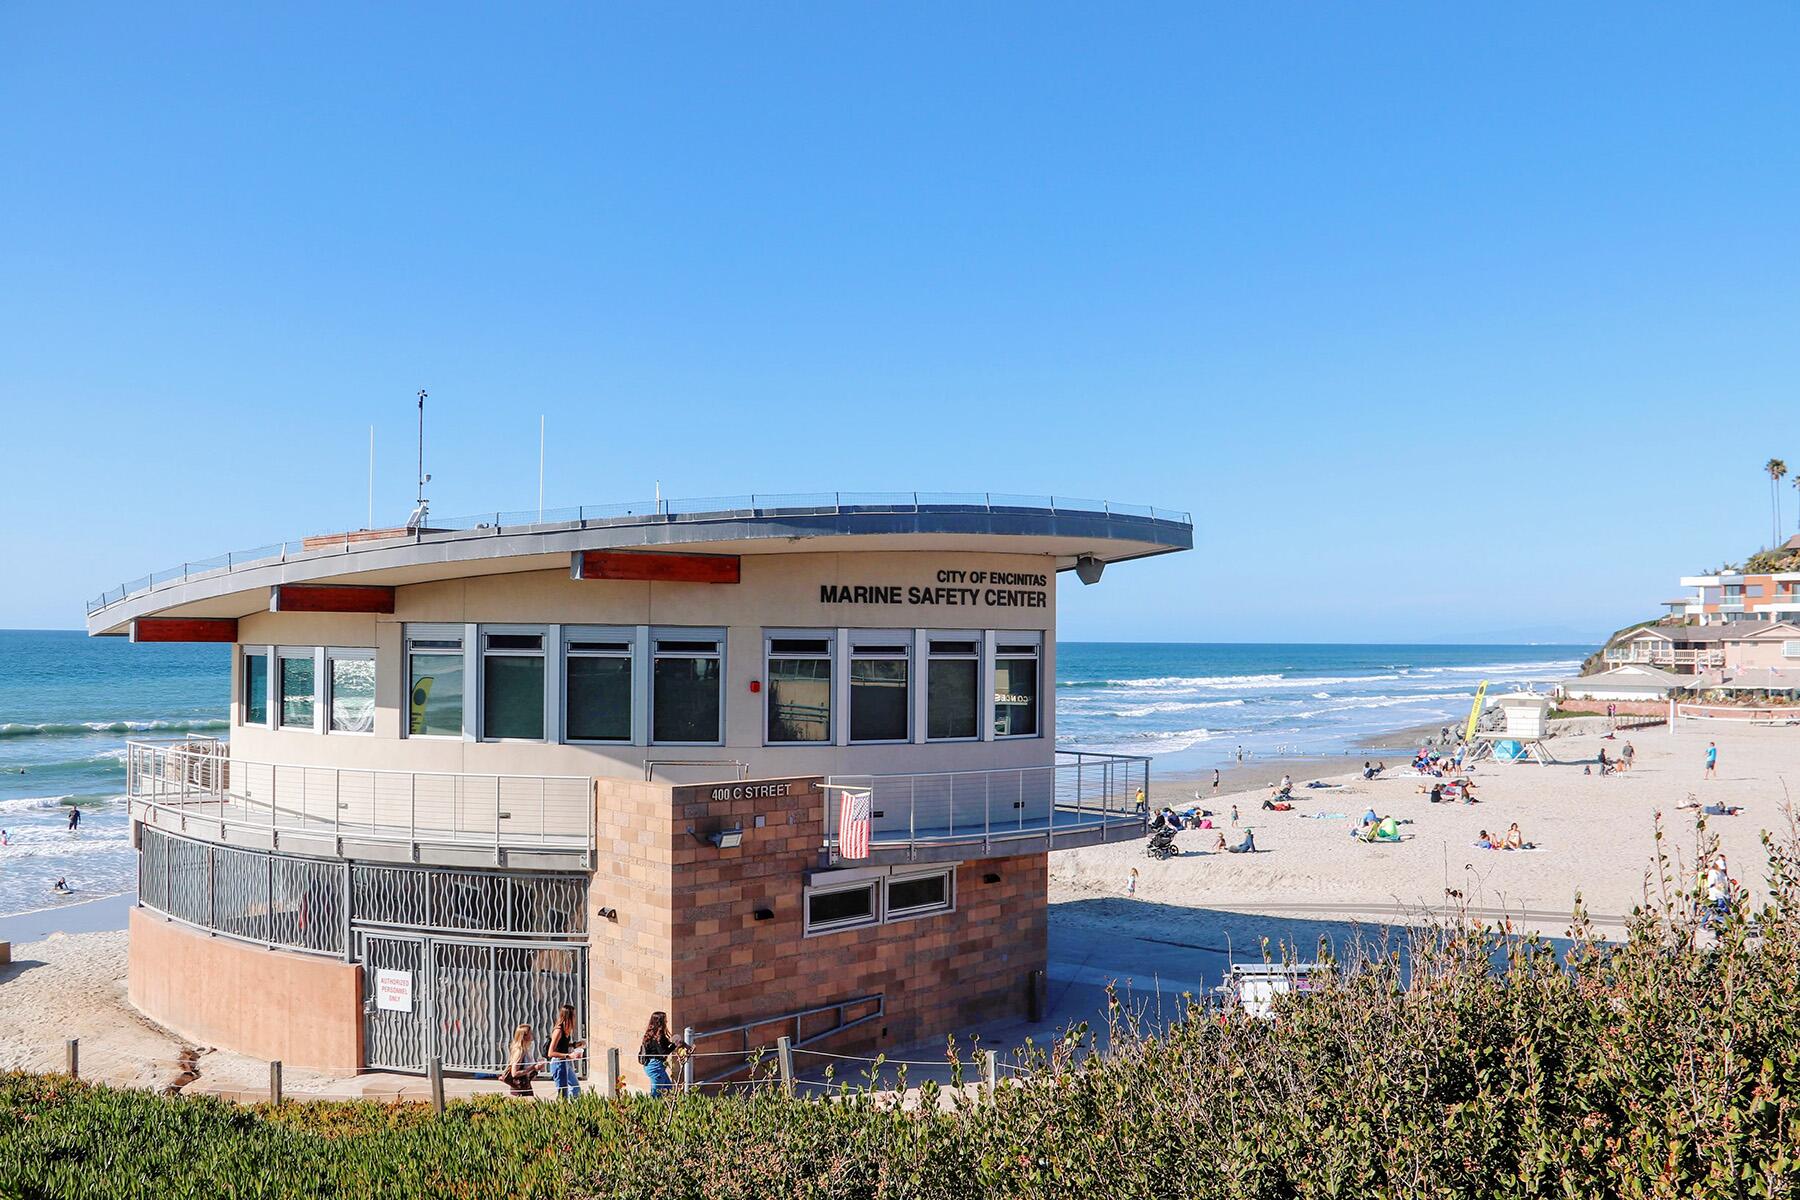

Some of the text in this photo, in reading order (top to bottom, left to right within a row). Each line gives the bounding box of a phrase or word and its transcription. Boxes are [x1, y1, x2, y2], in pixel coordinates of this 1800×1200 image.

[937, 570, 1047, 587] CITY OF ENCINITAS
[820, 585, 1047, 608] MARINE SAFETY CENTER
[712, 784, 792, 800] 400 C STREET
